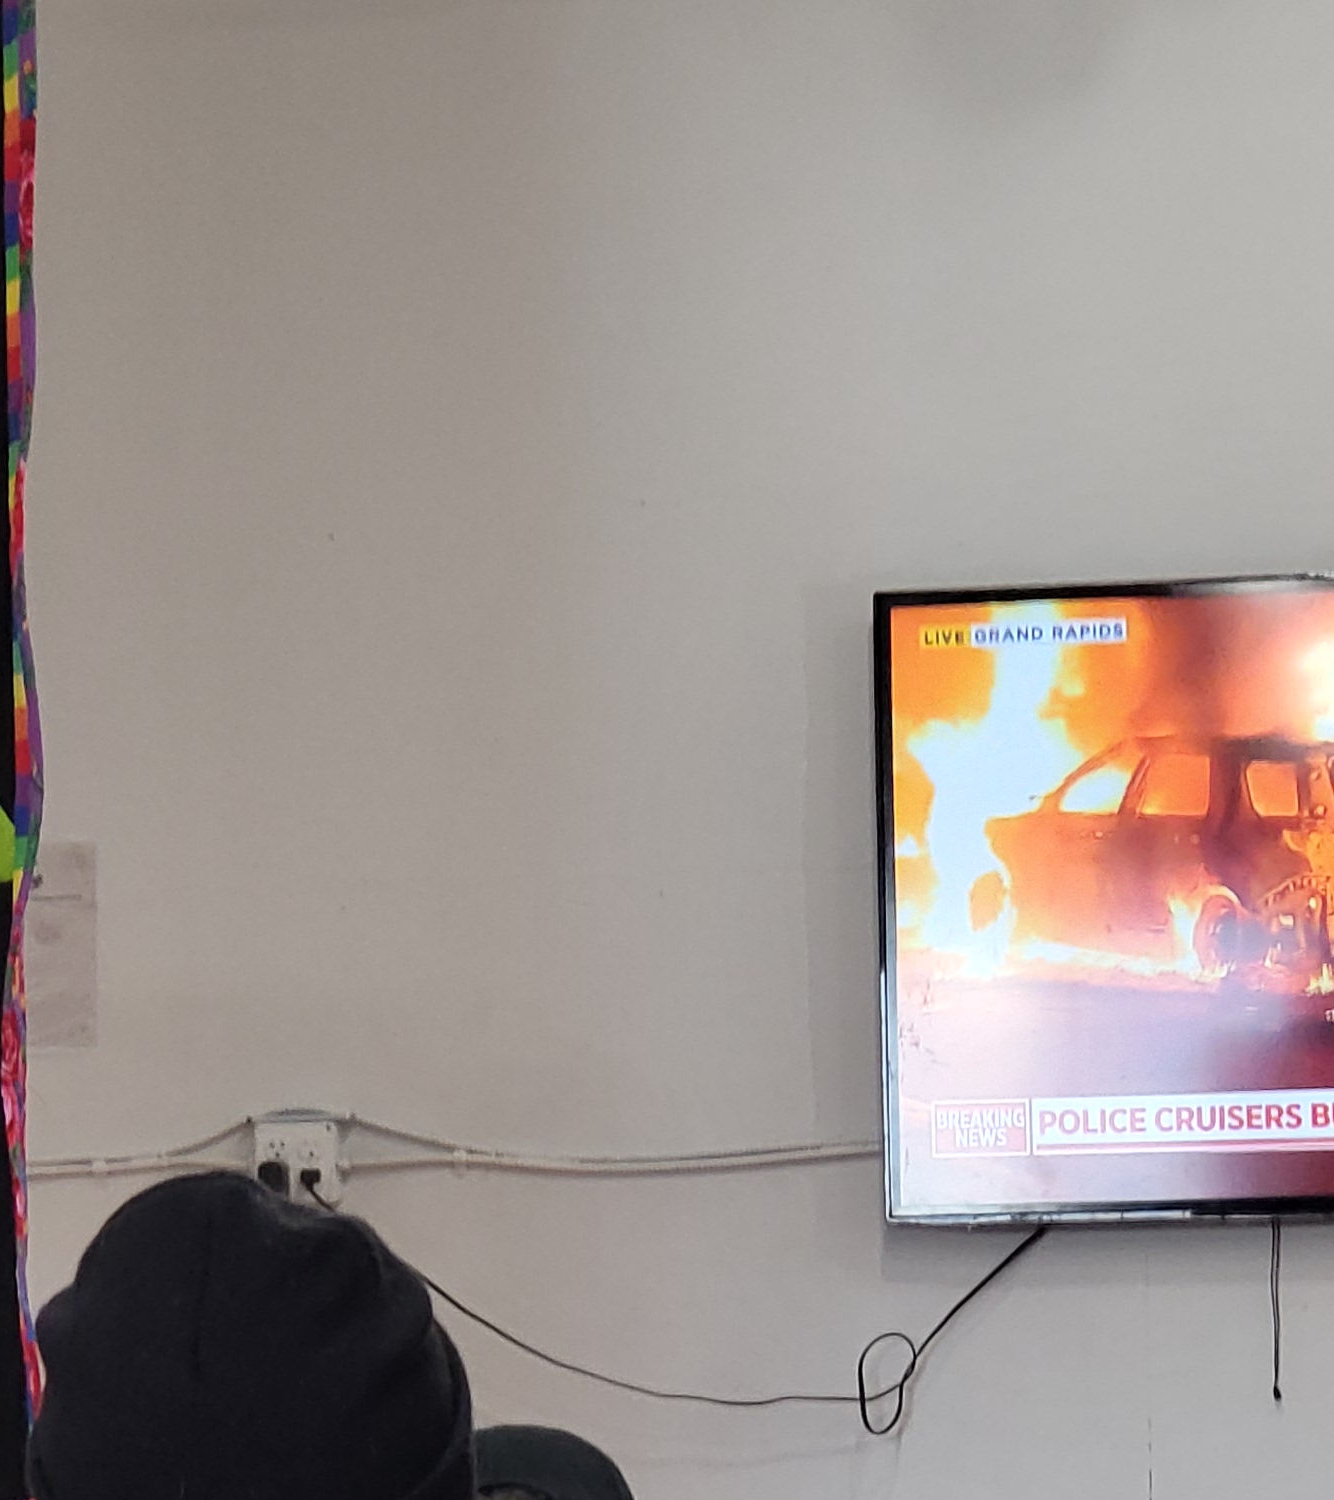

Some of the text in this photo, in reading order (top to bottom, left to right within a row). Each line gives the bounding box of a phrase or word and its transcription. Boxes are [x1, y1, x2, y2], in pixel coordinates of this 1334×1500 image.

[924, 622, 1124, 646] LIVE GRAND RAPIDS
[936, 1107, 1026, 1132] BREAKING
[1038, 1107, 1147, 1136] POLICE
[1154, 1103, 1303, 1133] CRUISERS
[954, 1126, 1008, 1148] NEWS
